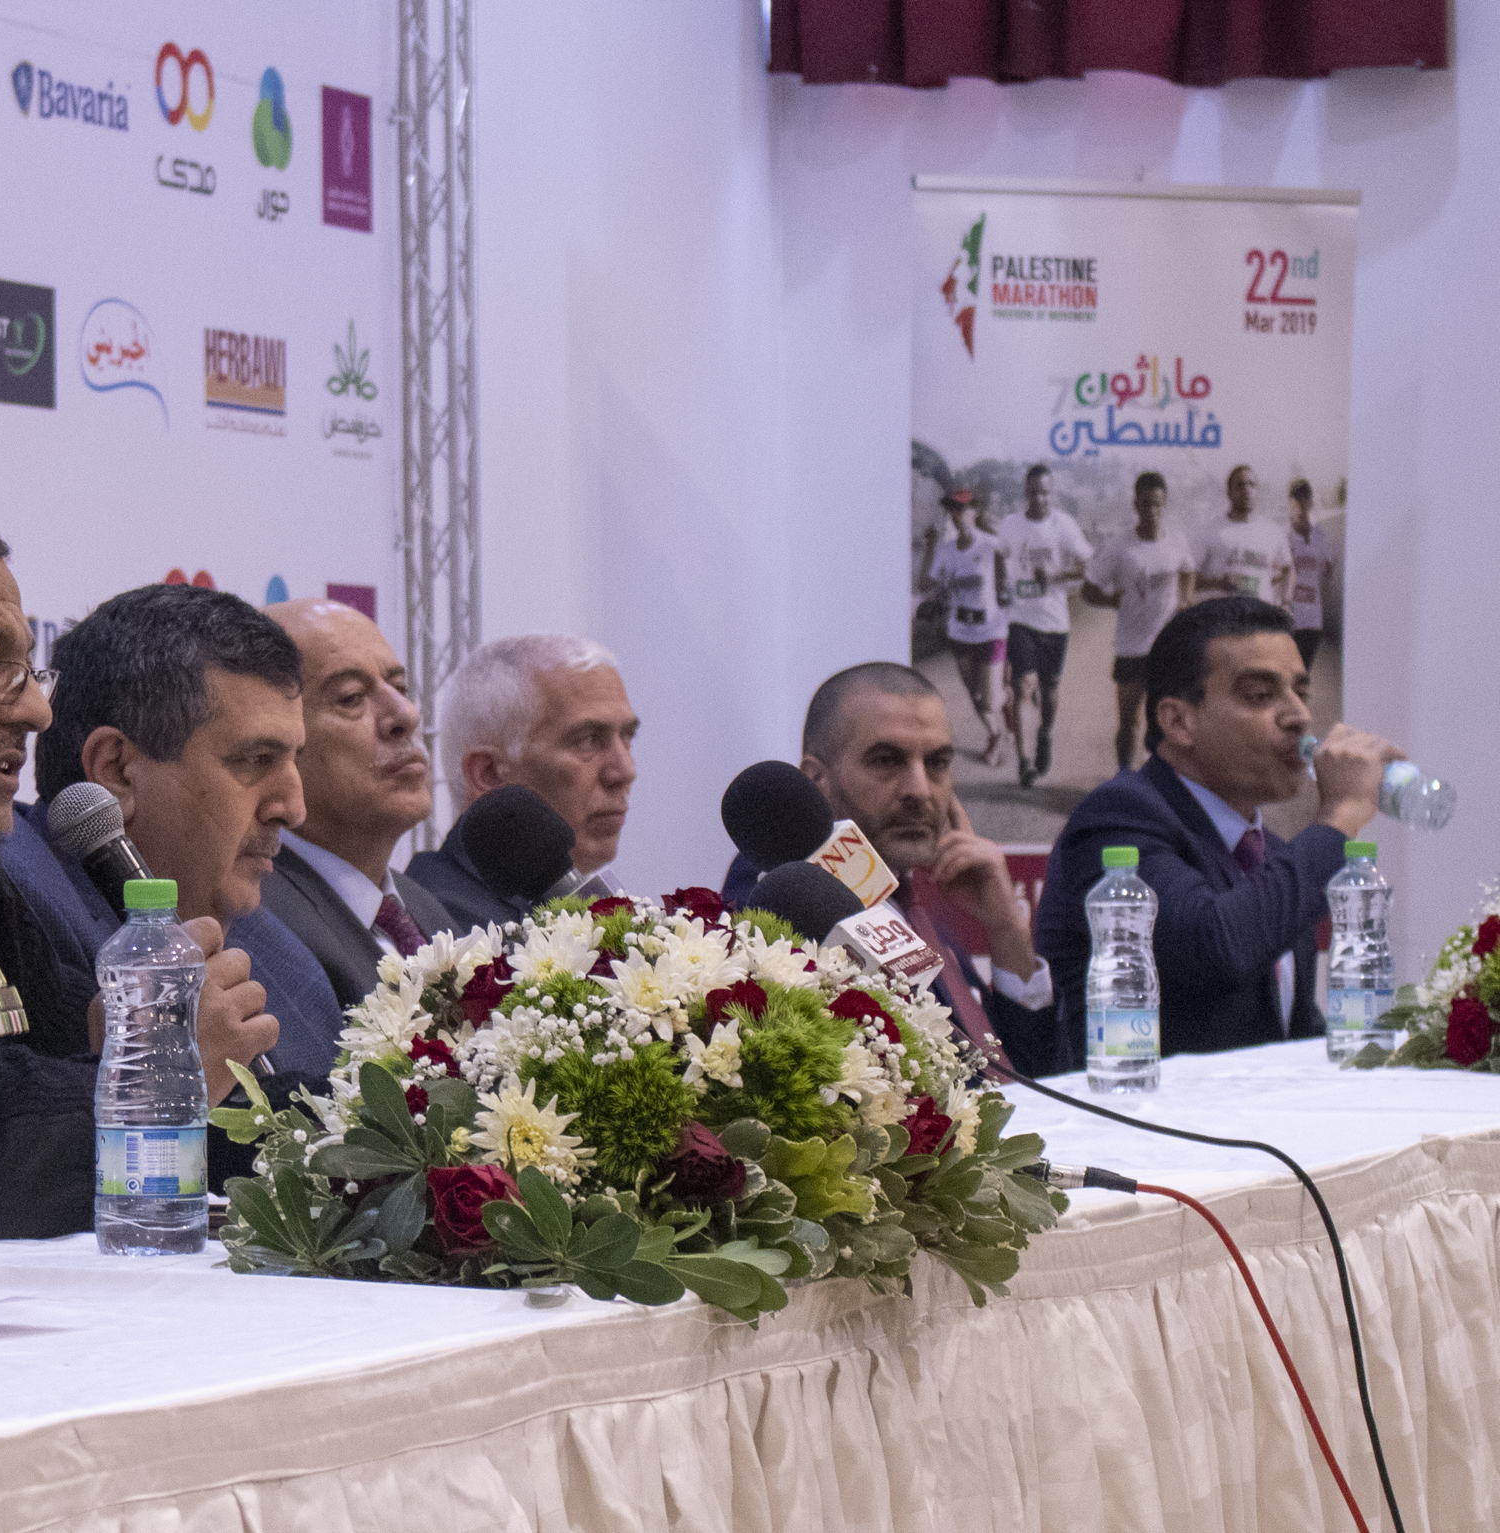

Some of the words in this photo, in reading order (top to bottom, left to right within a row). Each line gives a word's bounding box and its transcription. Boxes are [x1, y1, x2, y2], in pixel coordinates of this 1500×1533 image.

[38, 69, 129, 132] Bavaria
[992, 255, 1098, 282] PALESTINE
[992, 283, 1098, 309] MARATHON
[1245, 311, 1276, 332] Mar
[1280, 312, 1317, 335] 2019
[1050, 405, 1222, 457] فلسطين
[814, 828, 864, 873] NN
